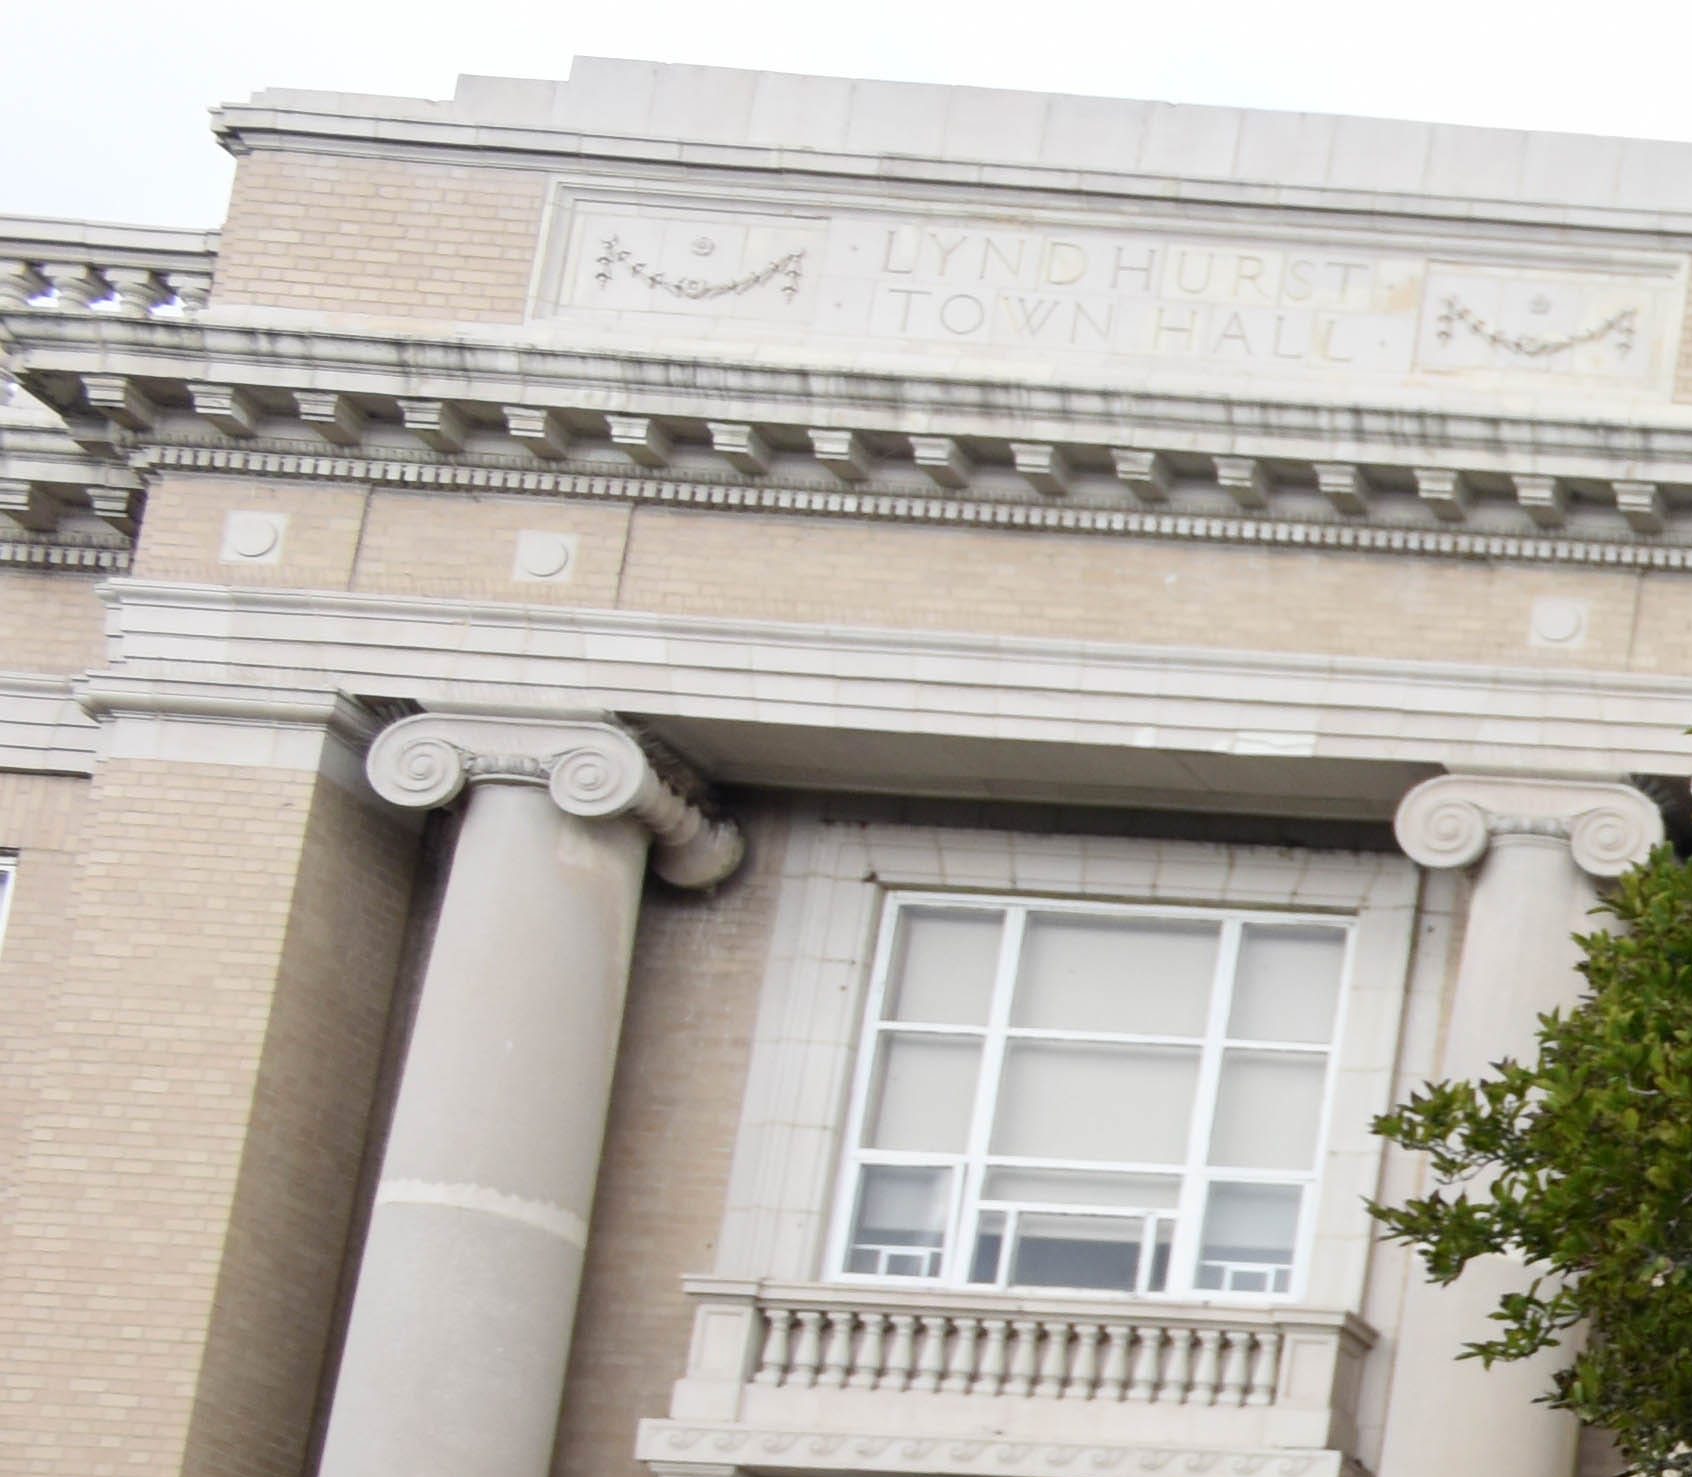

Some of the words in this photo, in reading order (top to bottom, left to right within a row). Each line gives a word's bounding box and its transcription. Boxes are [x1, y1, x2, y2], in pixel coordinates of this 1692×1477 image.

[881, 229, 1370, 302] LYNDHURST
[887, 286, 1117, 346] TOWN
[1153, 305, 1353, 363] HALL
